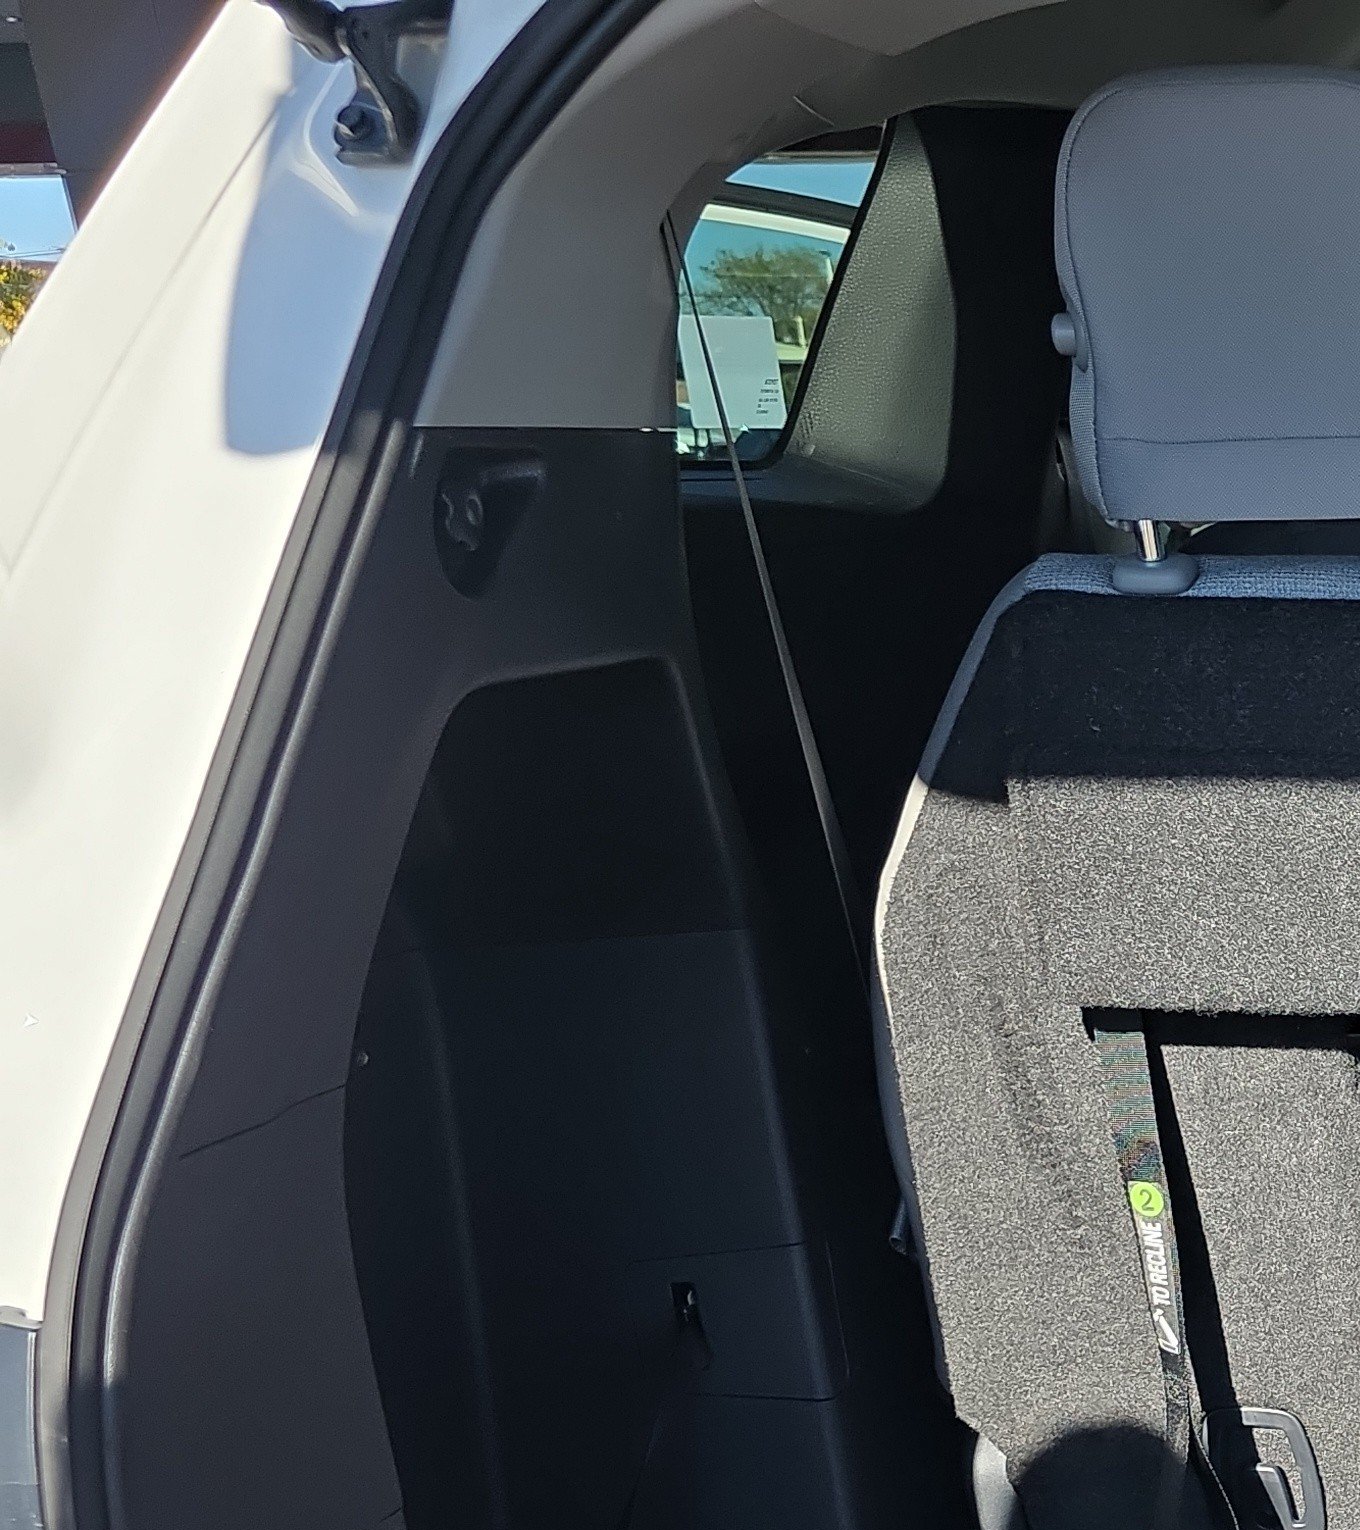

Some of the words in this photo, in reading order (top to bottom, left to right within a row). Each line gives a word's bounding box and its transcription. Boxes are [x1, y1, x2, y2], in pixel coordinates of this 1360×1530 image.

[1139, 1189, 1154, 1212] 2
[1140, 1220, 1169, 1286] RECLINE
[1152, 1285, 1171, 1306] TO
